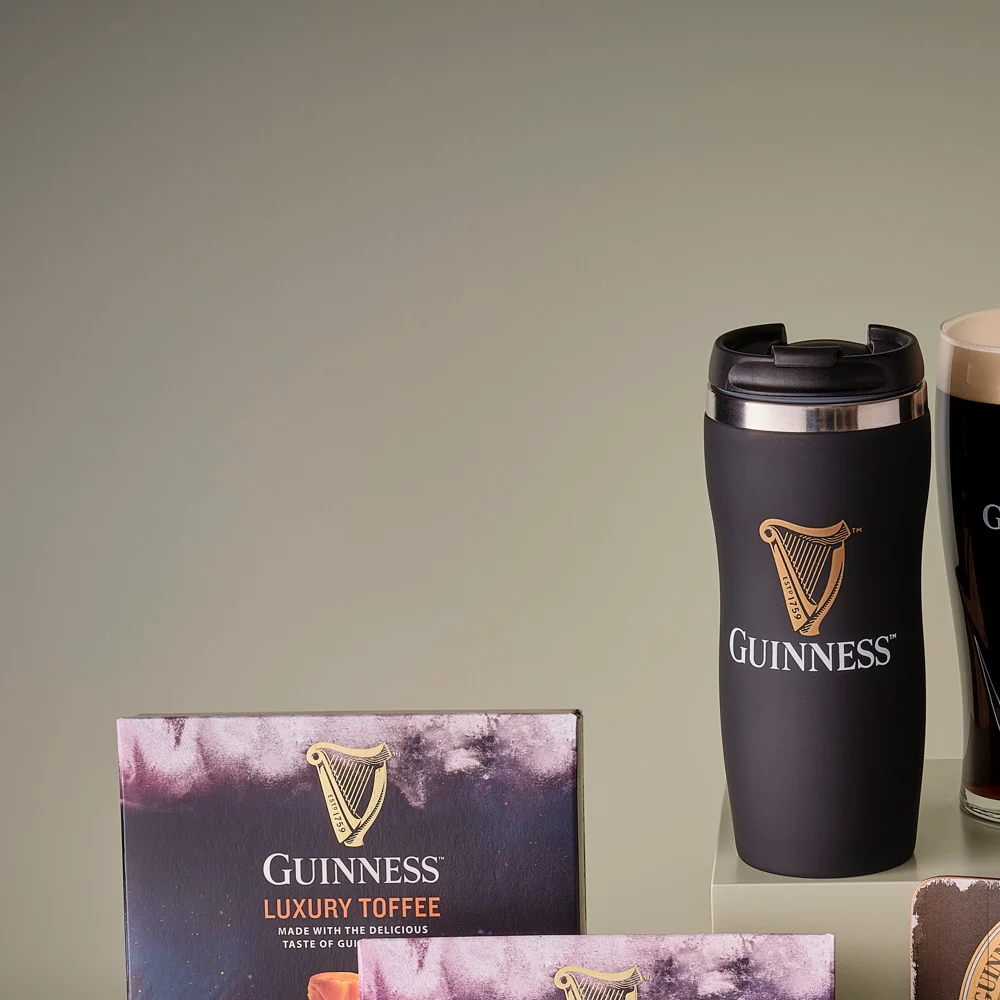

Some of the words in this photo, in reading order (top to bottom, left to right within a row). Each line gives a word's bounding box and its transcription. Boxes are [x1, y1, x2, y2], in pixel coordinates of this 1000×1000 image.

[788, 596, 802, 620] 1759
[264, 898, 352, 920] LUXURY
[358, 897, 441, 918] TOFFEE
[278, 927, 310, 936] MADE
[312, 926, 342, 935] WITH
[344, 926, 366, 935] THE
[369, 925, 428, 934] DELICIOUS
[282, 940, 316, 948] TASTE
[320, 940, 334, 948] OF
